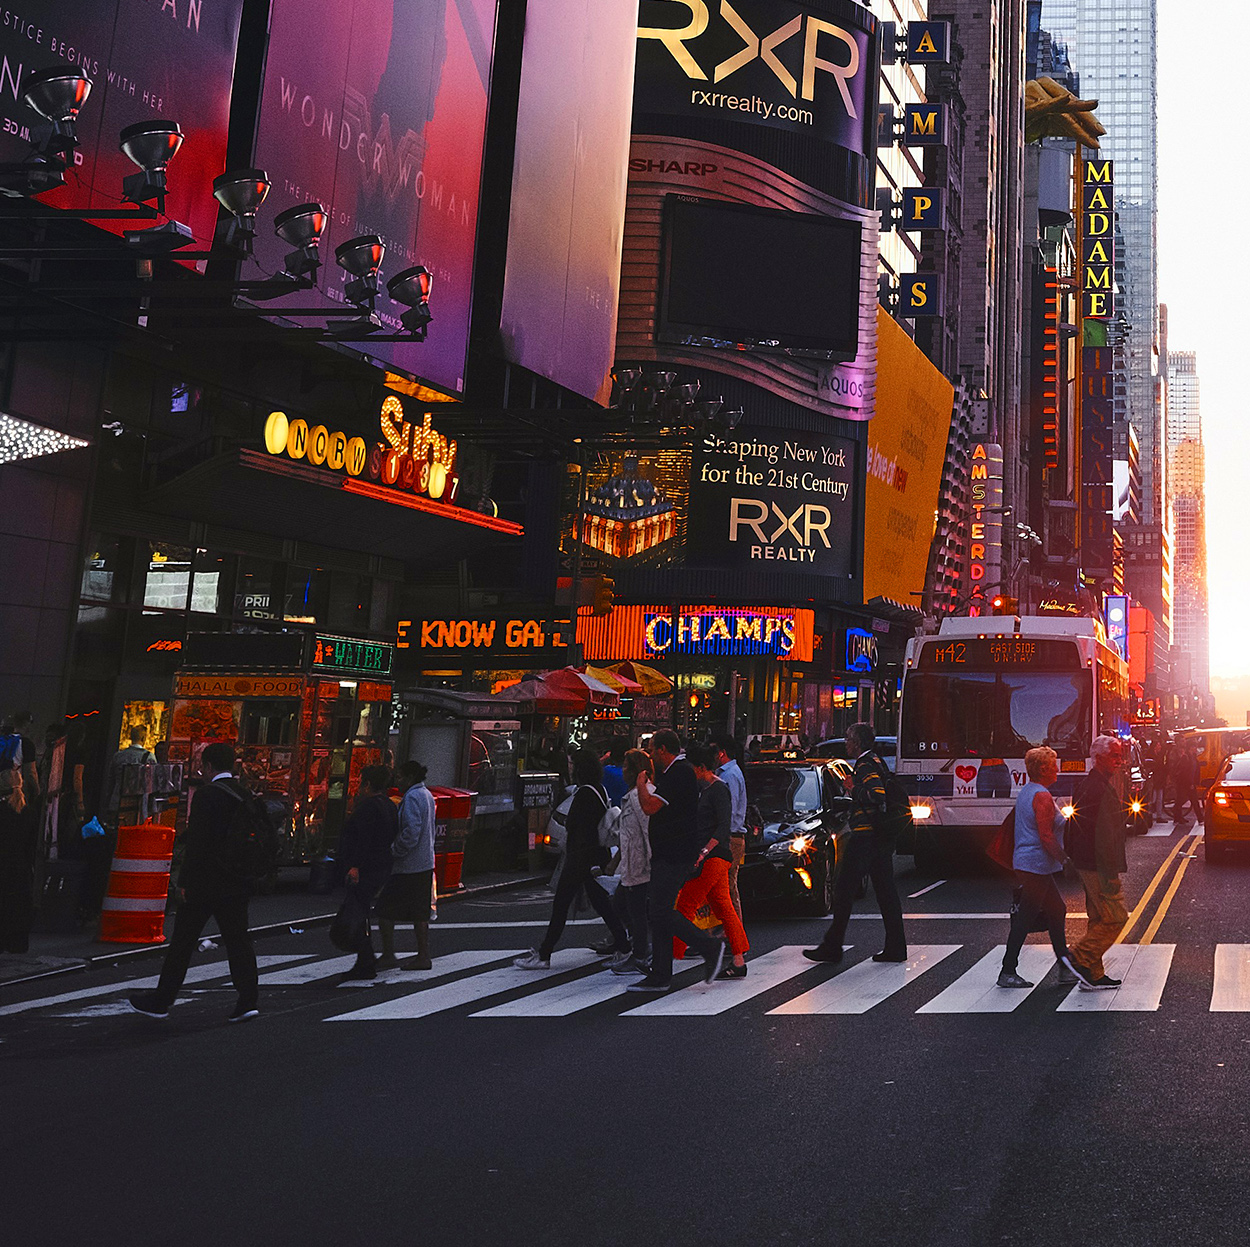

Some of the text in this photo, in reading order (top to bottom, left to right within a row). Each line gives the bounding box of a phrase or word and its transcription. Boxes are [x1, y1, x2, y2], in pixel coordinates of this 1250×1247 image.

[51, 37, 99, 76] BEGINS
[107, 68, 136, 97] WITH
[142, 90, 164, 113] HER
[691, 88, 813, 126] rxrrealty.com
[281, 77, 470, 226] WONDER WOMAN
[629, 158, 718, 177] SHARP
[285, 179, 300, 199] THE
[340, 212, 351, 226] OF
[1086, 160, 1111, 317] MADAME
[821, 378, 863, 399] AQUOS
[783, 441, 817, 462] New
[821, 446, 846, 468] York
[700, 462, 849, 501] for the 21st Century
[729, 497, 832, 549] RXR
[751, 545, 816, 563] REALTY
[420, 620, 496, 648] KNOW
[645, 614, 796, 652] CHAMPS
[335, 642, 383, 669] WATER
[935, 643, 966, 663] M42
[1015, 643, 1035, 653] SIDE
[180, 681, 299, 693] HALAL FOOD
